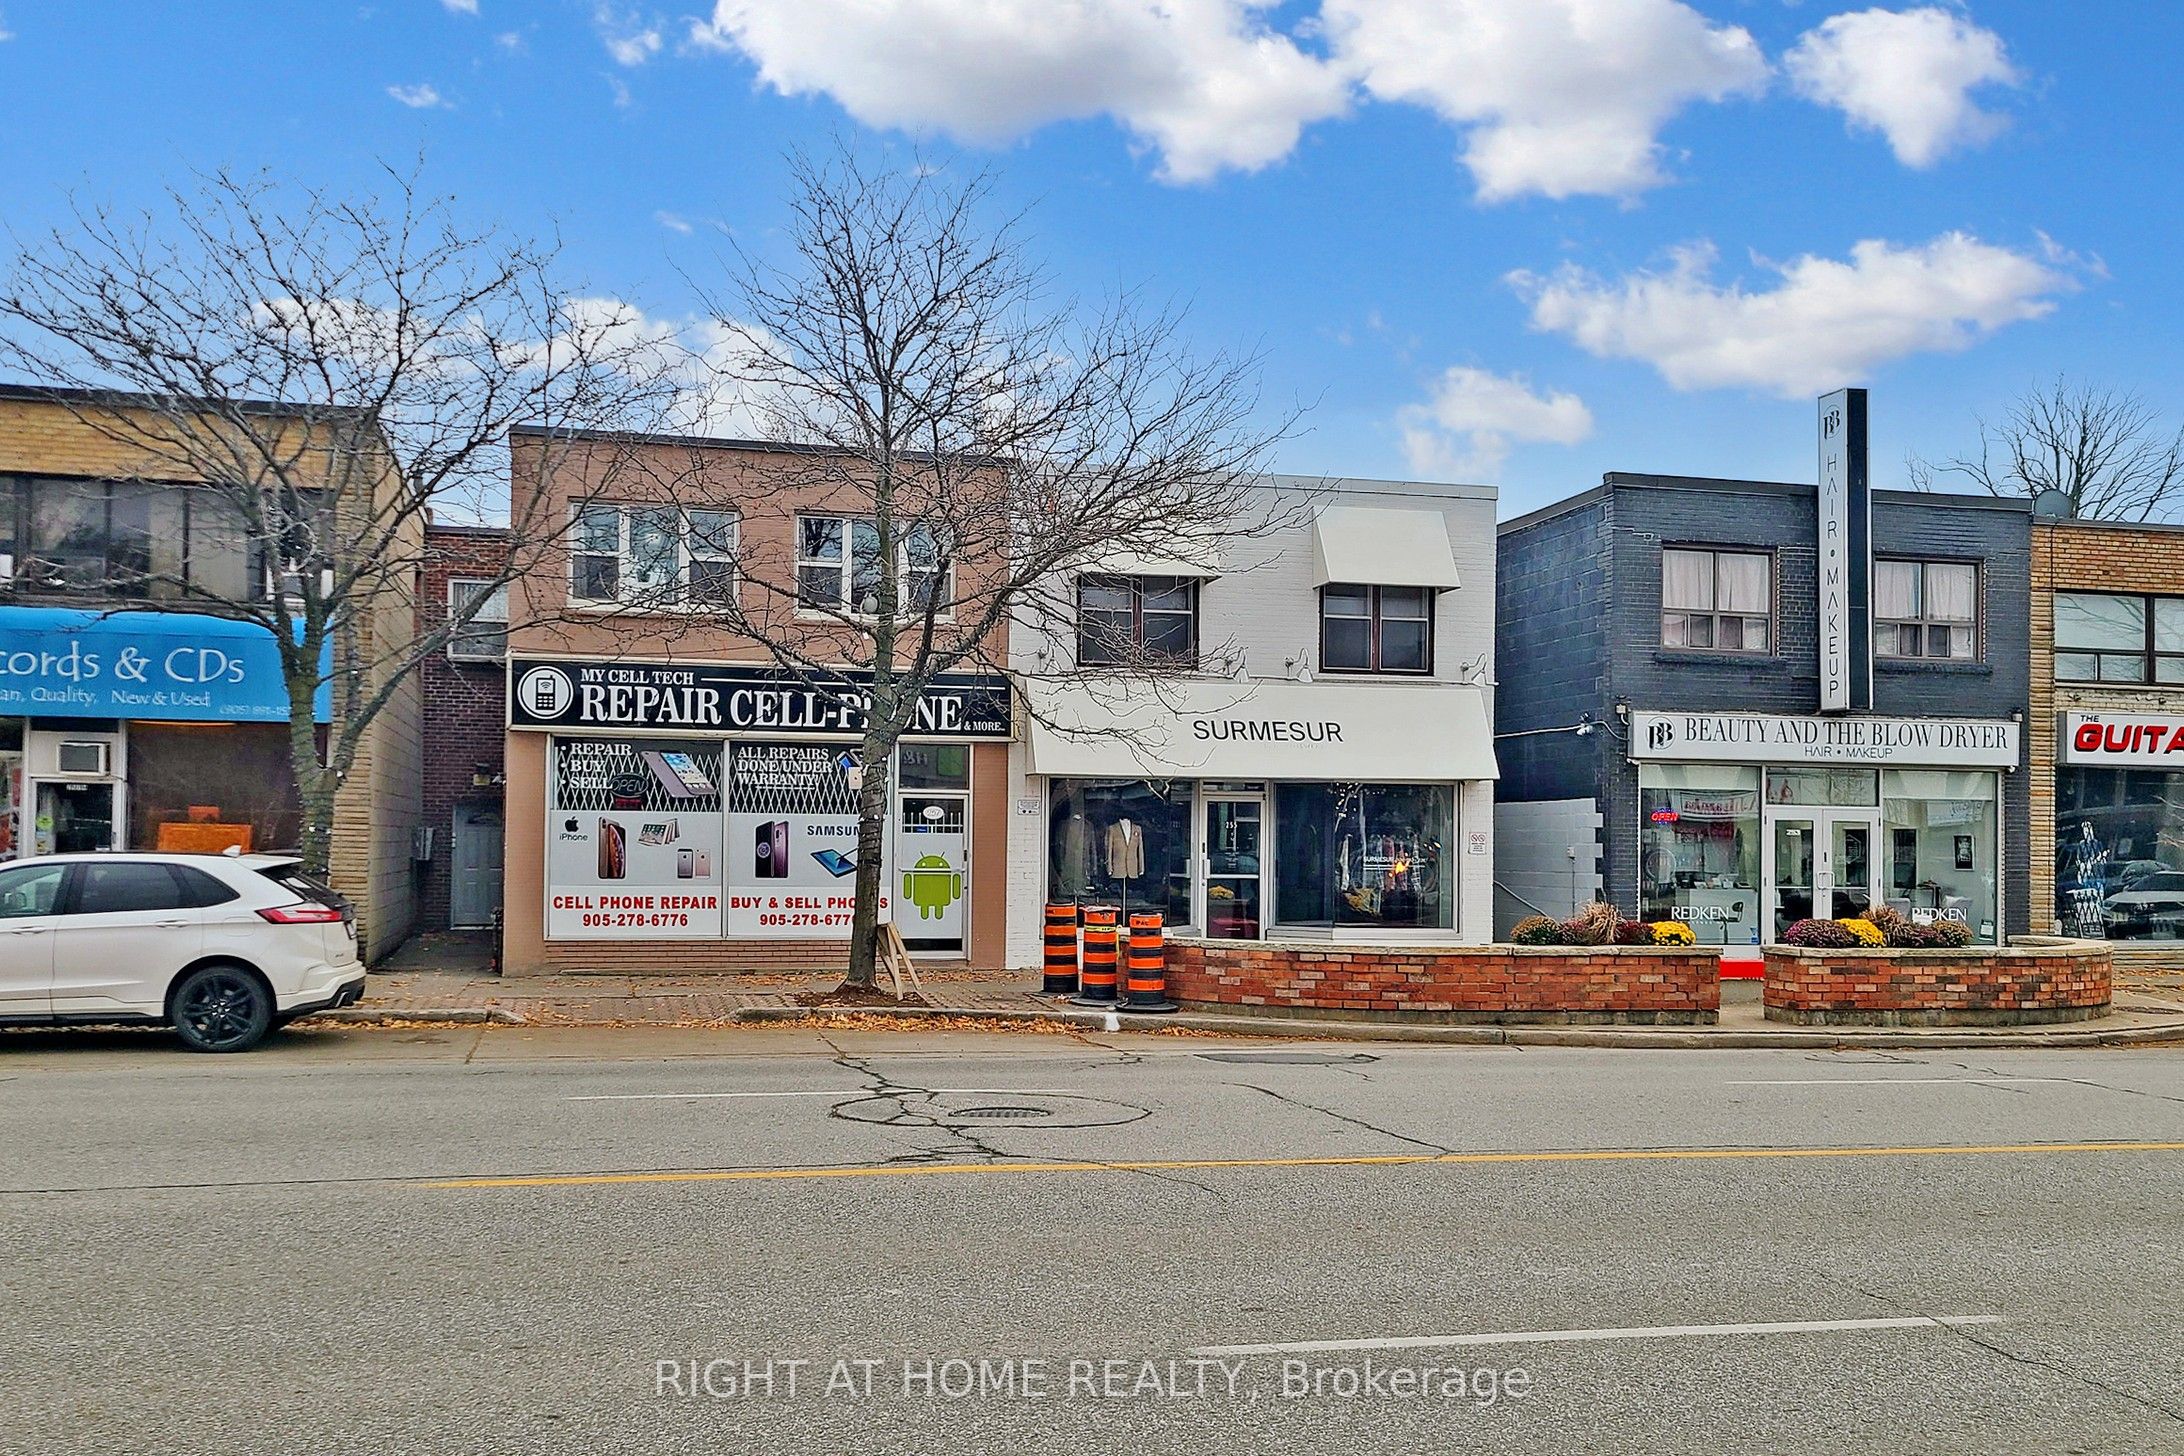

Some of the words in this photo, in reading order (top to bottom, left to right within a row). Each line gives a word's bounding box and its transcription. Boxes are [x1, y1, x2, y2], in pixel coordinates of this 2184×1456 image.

[1826, 454, 1839, 539] HAIR
[1826, 567, 1840, 699] MAKEUP
[114, 646, 151, 683] &
[164, 647, 246, 683] CDs
[580, 668, 604, 682] MY
[607, 669, 650, 684] CELL
[652, 671, 695, 686] TECH
[30, 685, 97, 707] Quality,
[111, 690, 150, 704] New
[151, 691, 168, 706] &
[171, 691, 211, 708] Used
[580, 684, 721, 724] REPAIR
[730, 689, 962, 731] CELL-PNE
[2080, 714, 2100, 722] THE
[1193, 720, 1344, 742] SURMESUR
[1685, 717, 1770, 743] BEAUTY
[1774, 721, 1818, 744] AND
[1823, 721, 1866, 745] THE
[1871, 723, 1933, 747] BLOW
[1938, 725, 2008, 749] DRYER
[2074, 723, 2184, 754] GUITA
[570, 743, 632, 756] REPAIR
[737, 747, 767, 759] ALL
[769, 747, 829, 760] REPAIRS
[1804, 746, 1832, 757] HAIR
[1846, 747, 1893, 759] MAKEUP
[570, 760, 605, 772] BUY
[738, 761, 778, 773] DONE
[782, 761, 832, 773] UNDER
[570, 777, 613, 789] SELL
[738, 773, 817, 786] WARRANTY
[559, 833, 588, 842] iPhone
[807, 825, 861, 837] SAMSUN
[553, 896, 593, 909] CELL
[599, 897, 655, 909] PHONE
[660, 896, 718, 909] REPAIR
[731, 897, 762, 909] BUY
[768, 897, 779, 909] &
[785, 897, 822, 909] SELL
[827, 897, 889, 909] PHOS
[1671, 906, 1729, 920] REDKEN
[582, 913, 689, 927] 905-278-6776
[759, 914, 856, 926] 905-278-677
